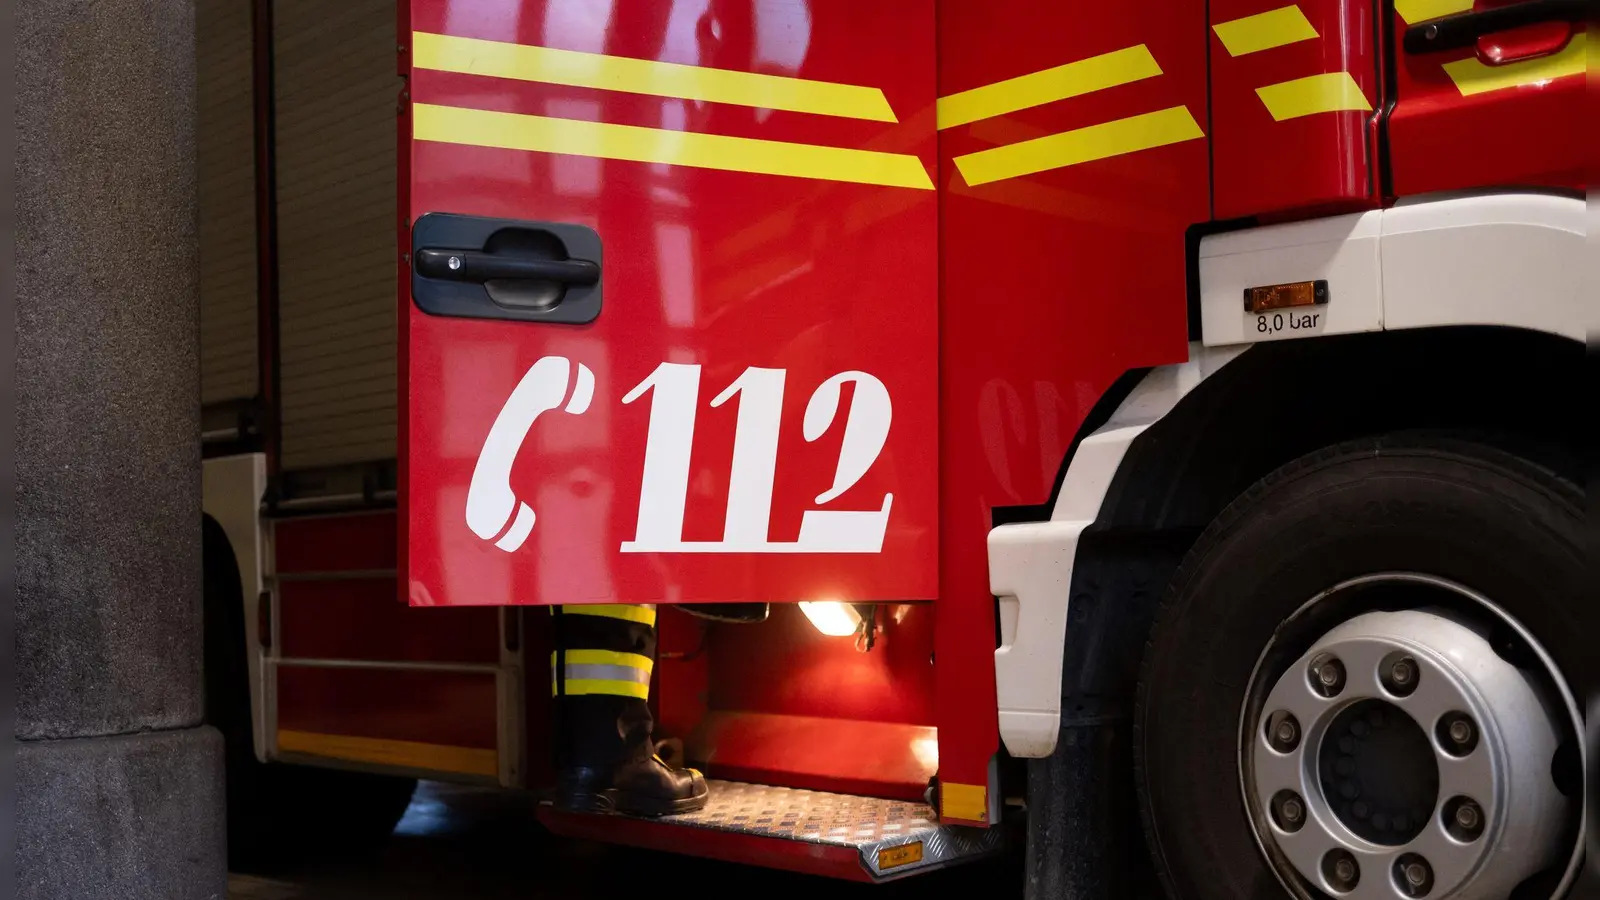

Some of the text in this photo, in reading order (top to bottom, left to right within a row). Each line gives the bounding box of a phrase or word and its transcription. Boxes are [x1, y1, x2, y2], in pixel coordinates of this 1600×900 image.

[1257, 312, 1320, 334] 8,0 bar
[620, 362, 893, 554] 112
